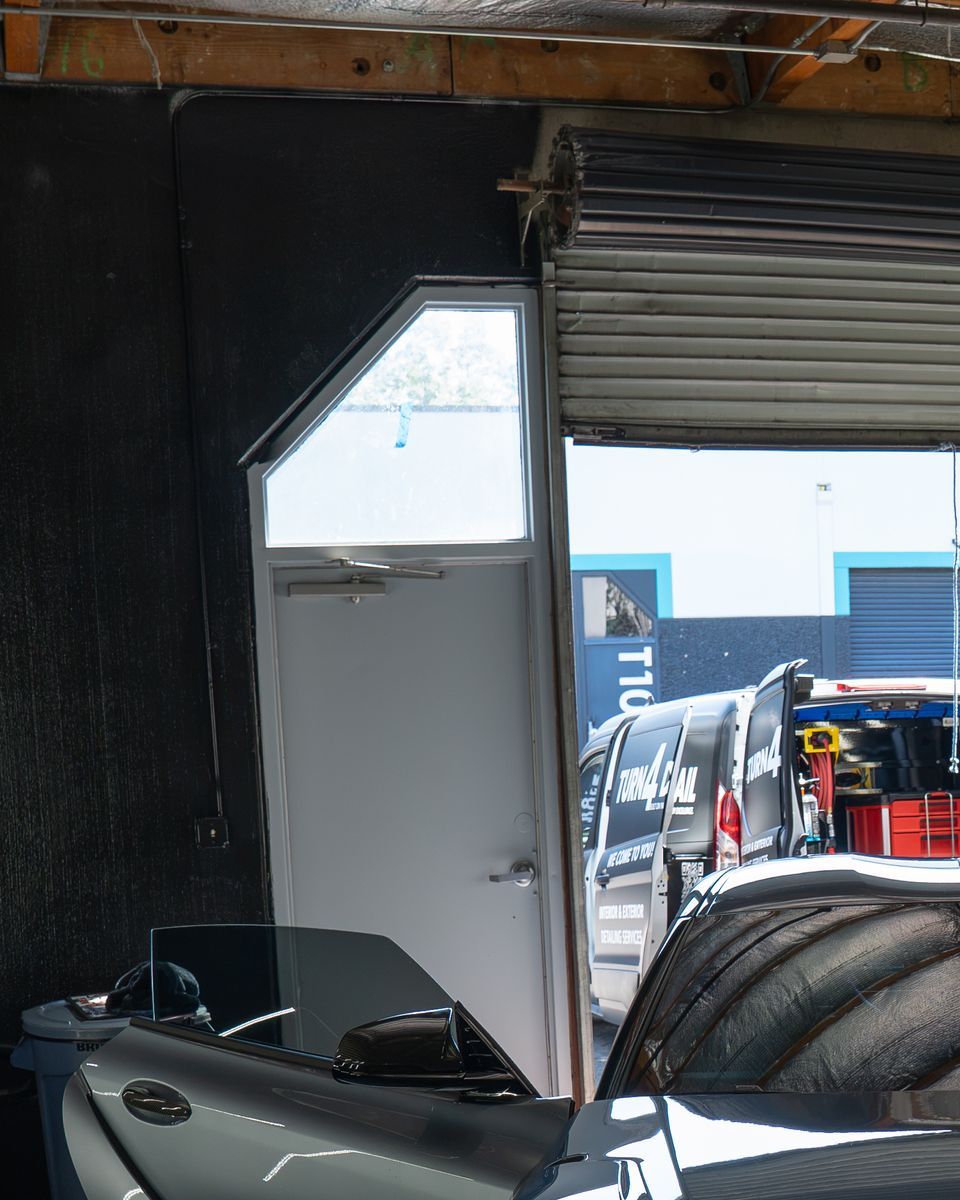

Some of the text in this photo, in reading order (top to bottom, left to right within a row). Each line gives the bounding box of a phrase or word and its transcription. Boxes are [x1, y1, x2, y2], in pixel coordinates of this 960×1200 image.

[607, 842, 656, 868] WE COME TO YOU!
[599, 905, 617, 920] INTERIOR
[622, 904, 644, 919] EXTERIOR
[600, 929, 643, 945] DETAILING SERVICES
